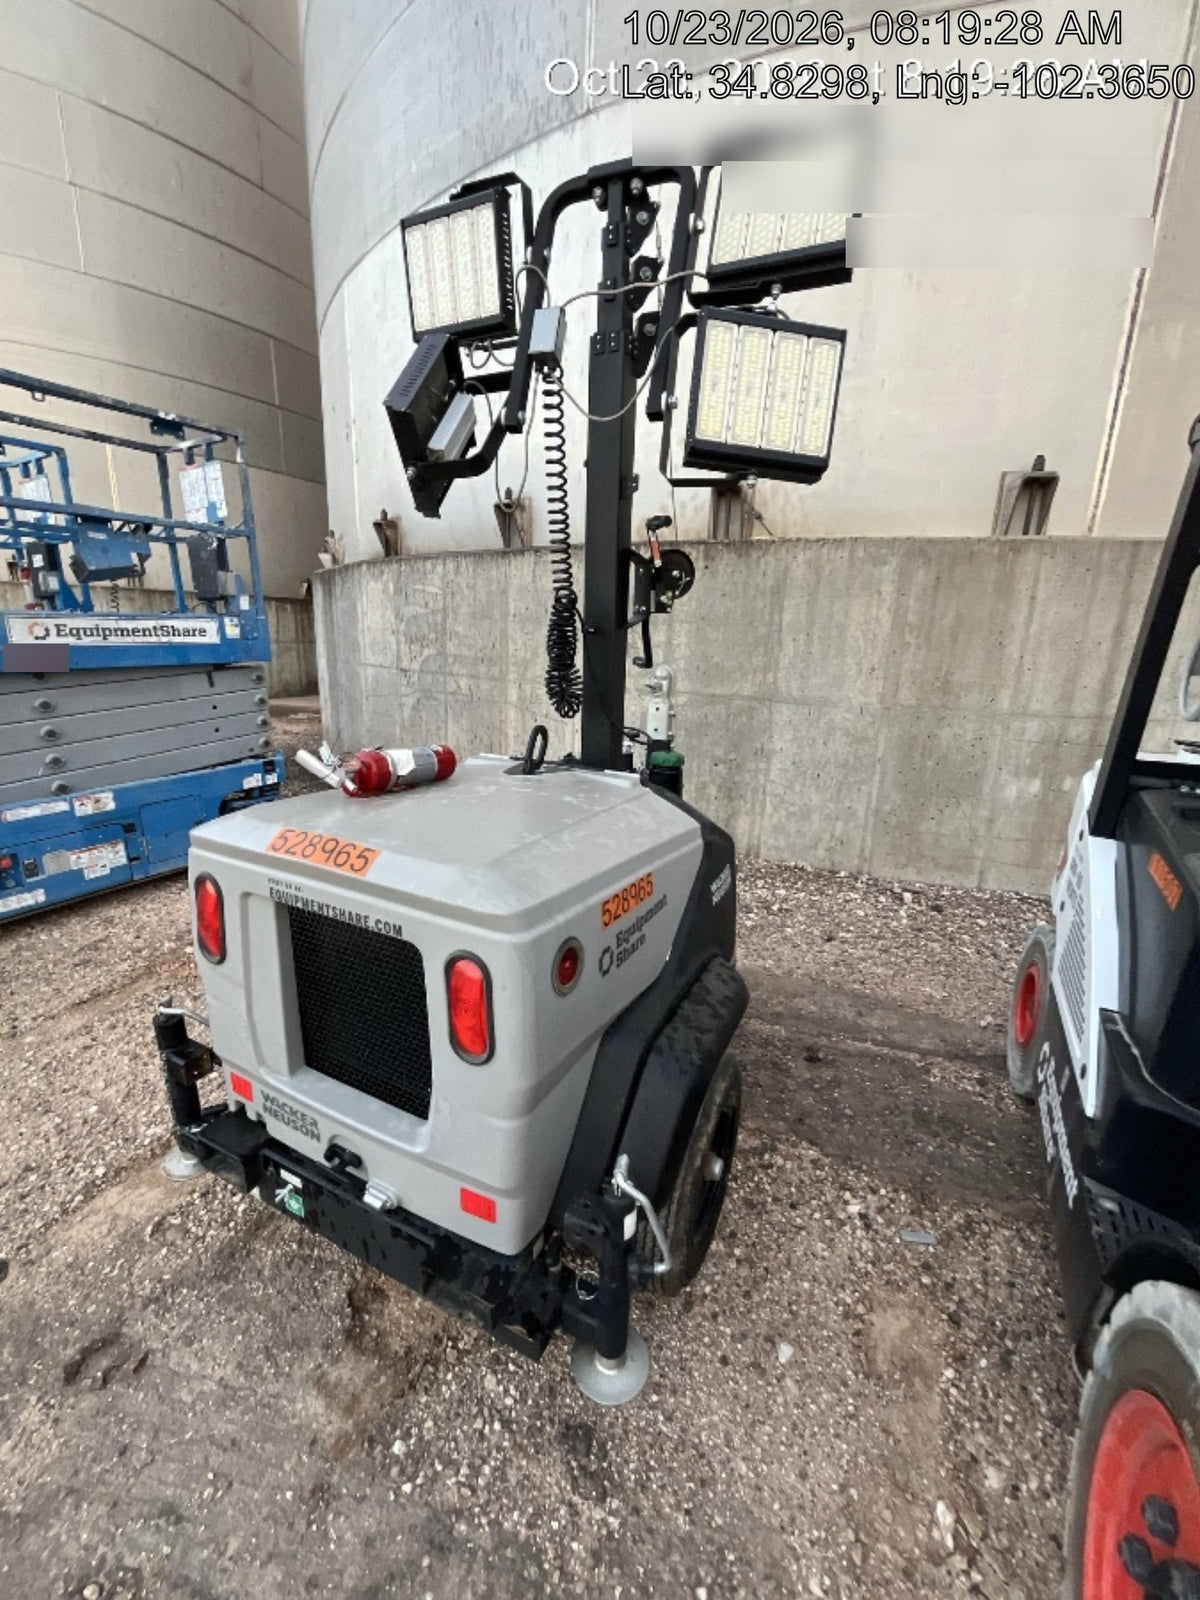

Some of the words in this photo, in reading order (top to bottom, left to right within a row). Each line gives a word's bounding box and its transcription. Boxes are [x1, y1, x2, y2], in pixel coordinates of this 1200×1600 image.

[54, 623, 207, 640] EquipmentShare
[271, 829, 376, 872] 528965
[269, 886, 403, 938] EQUIPMENTSHARE.COM
[601, 872, 653, 928] 528965
[616, 893, 667, 948] Equipment
[616, 933, 646, 968] Share
[261, 1089, 319, 1131] WACKER
[262, 1103, 321, 1143] NEUSON
